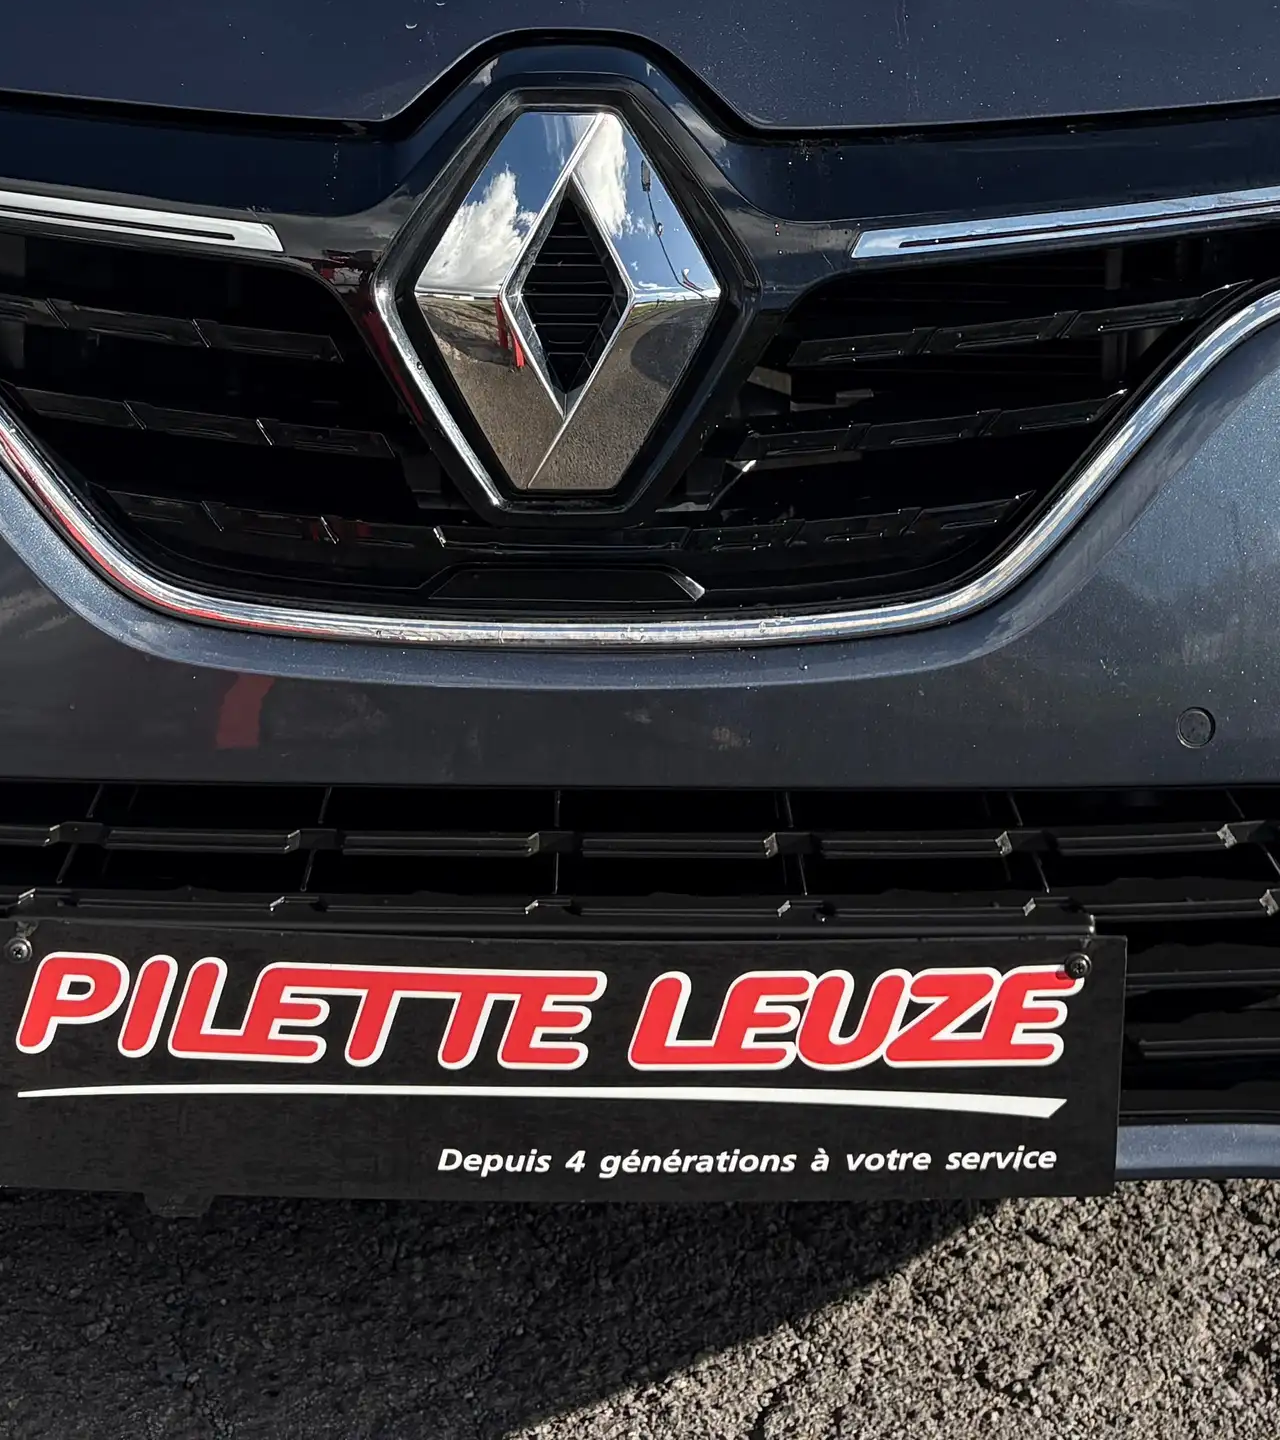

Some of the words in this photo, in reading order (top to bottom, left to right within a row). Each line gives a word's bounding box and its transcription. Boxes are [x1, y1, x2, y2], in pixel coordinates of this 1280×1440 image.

[16, 951, 607, 1070] PILETTE
[627, 964, 1084, 1071] LEUZE
[437, 1148, 552, 1178] Depuis
[564, 1150, 586, 1173] 4
[599, 1148, 796, 1179] générations
[810, 1147, 829, 1172] à
[846, 1149, 932, 1172] votre
[945, 1145, 1057, 1172] service
